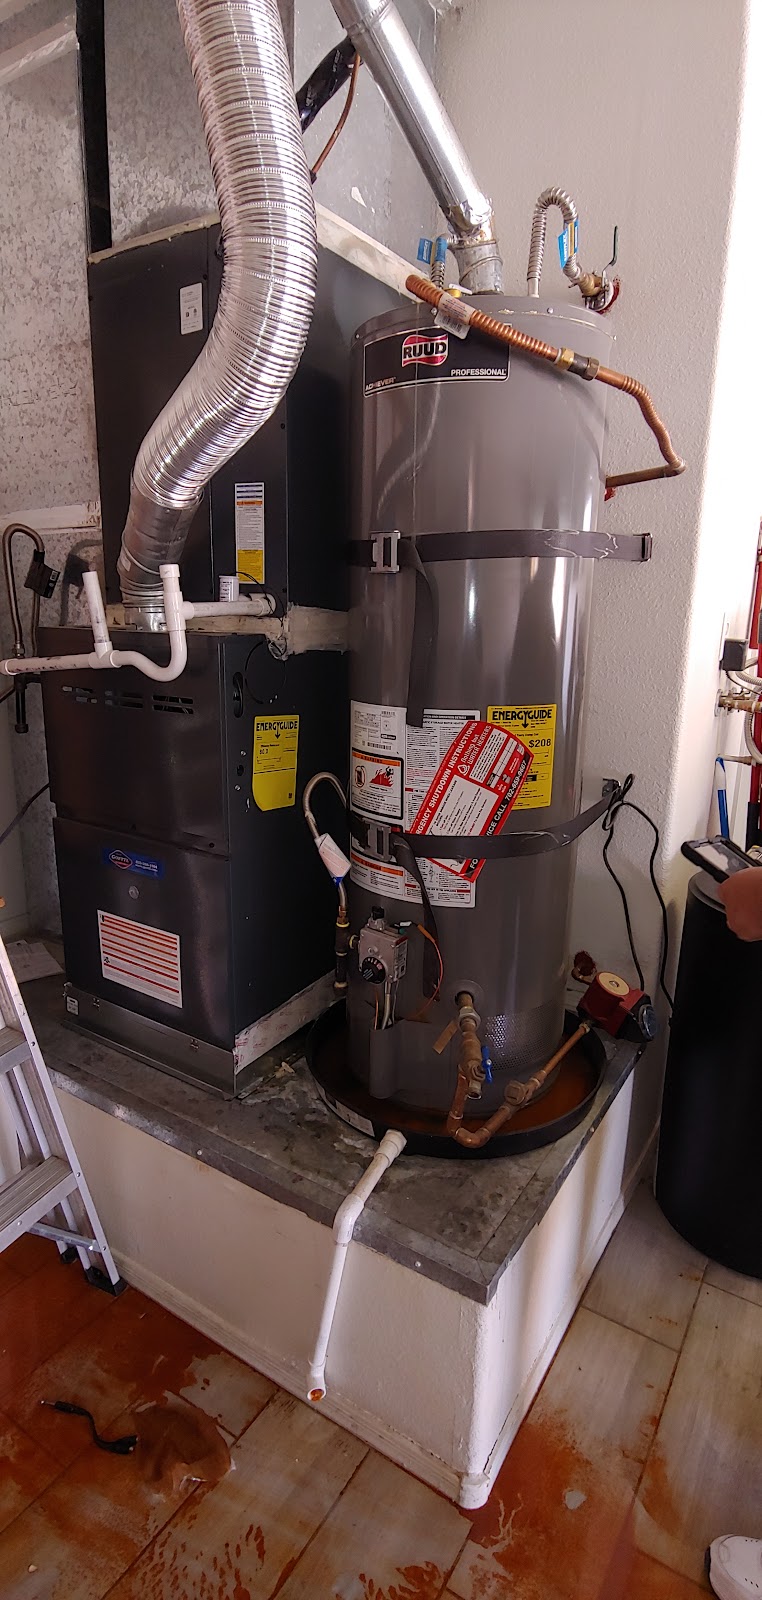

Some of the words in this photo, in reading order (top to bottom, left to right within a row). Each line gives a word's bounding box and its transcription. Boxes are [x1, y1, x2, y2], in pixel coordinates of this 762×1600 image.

[403, 341, 446, 359] RUUD
[451, 368, 506, 377] PROFESSIONAL
[492, 709, 553, 722] ENERGYGUIDE
[256, 721, 298, 732] ENERGYGUIDE
[529, 739, 552, 748] $208
[415, 806, 433, 835] RGENCY
[429, 769, 452, 809] SHUTDOWN
[447, 722, 478, 770] INSTRUCTIONS
[494, 803, 508, 822] CALL
